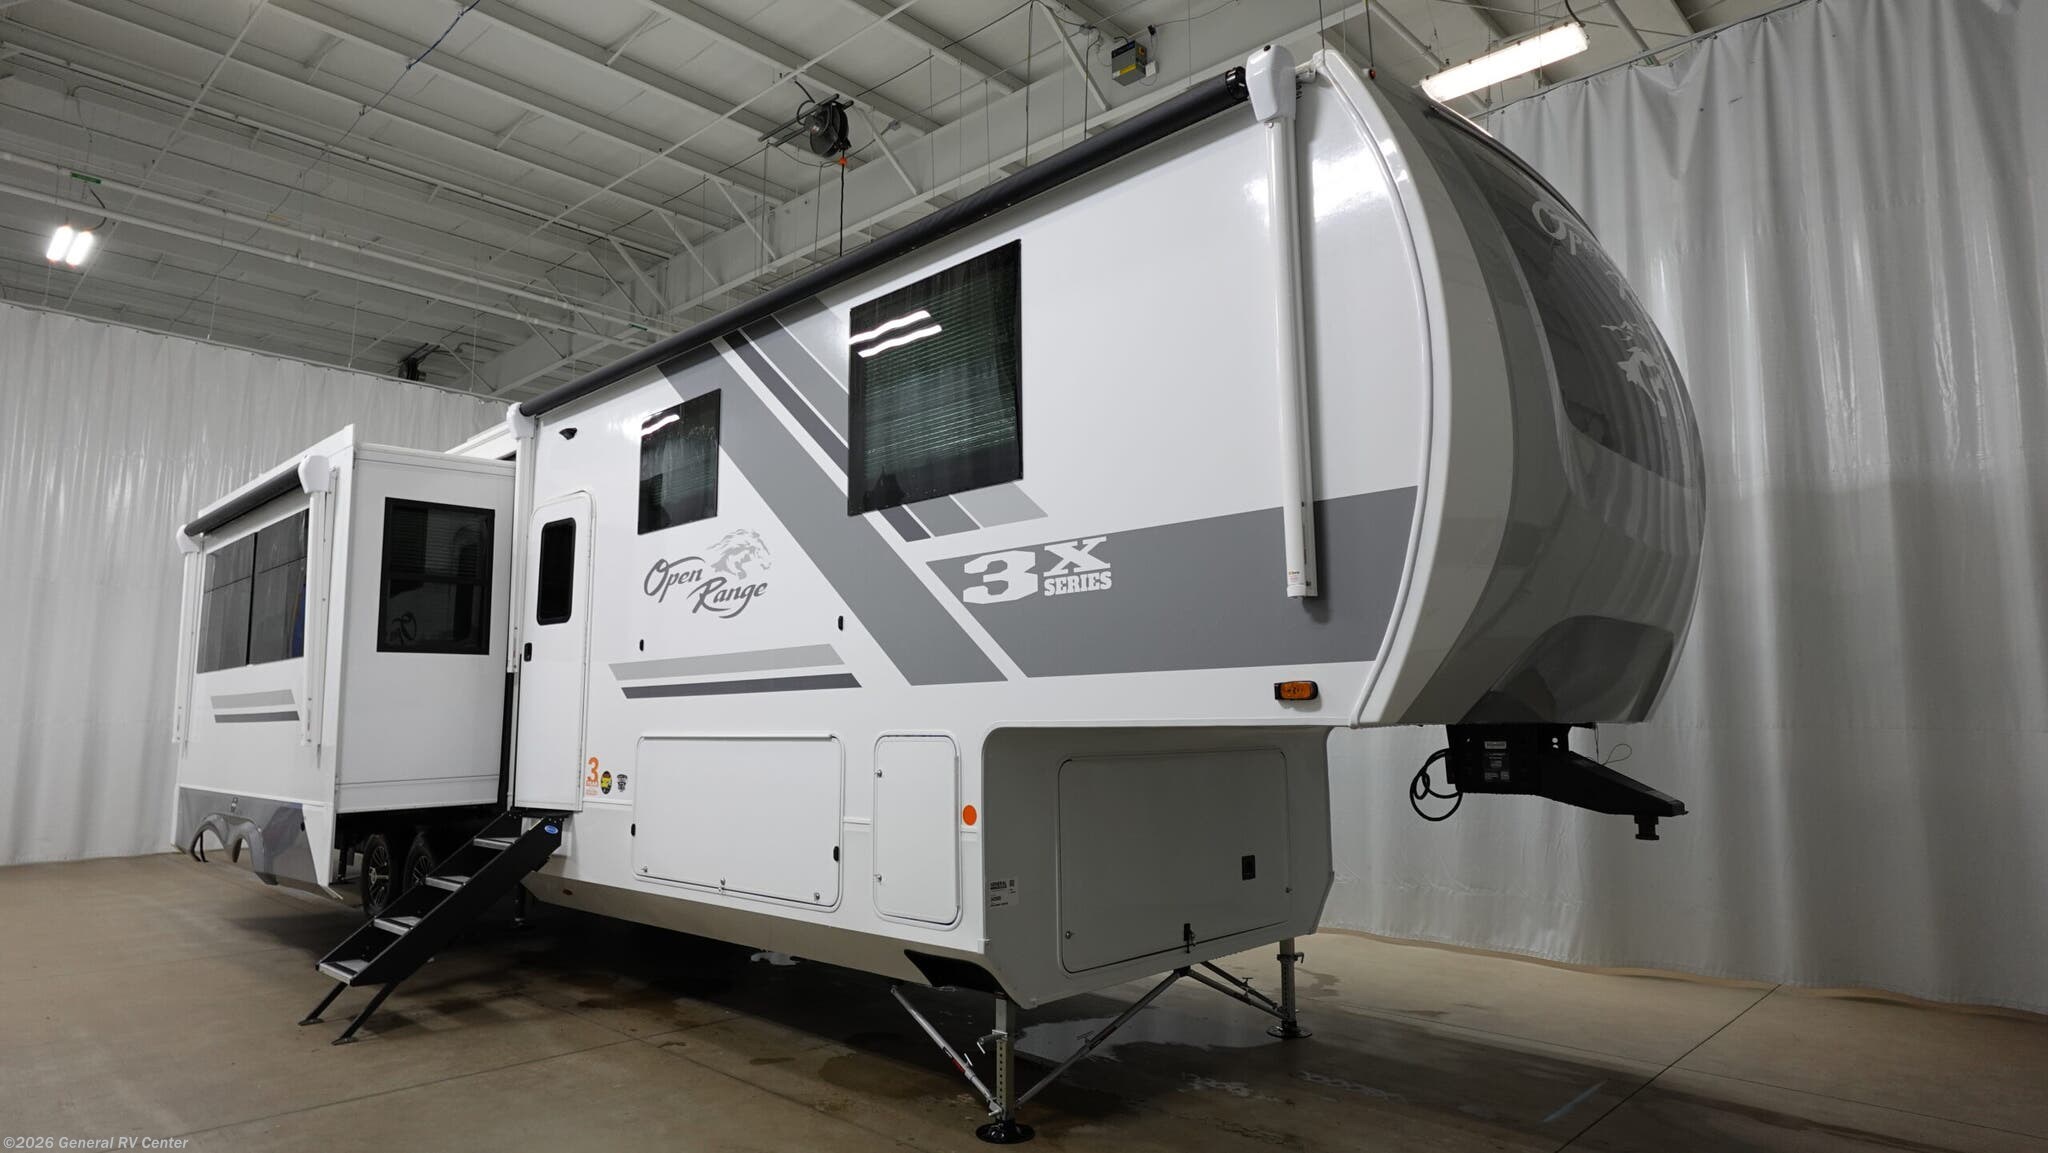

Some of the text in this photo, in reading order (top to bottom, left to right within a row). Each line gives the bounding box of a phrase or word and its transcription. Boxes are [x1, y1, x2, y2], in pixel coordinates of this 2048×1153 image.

[644, 556, 705, 603] Open
[1044, 571, 1112, 596] SERIES
[686, 576, 768, 619] Range
[587, 757, 599, 782] 3
